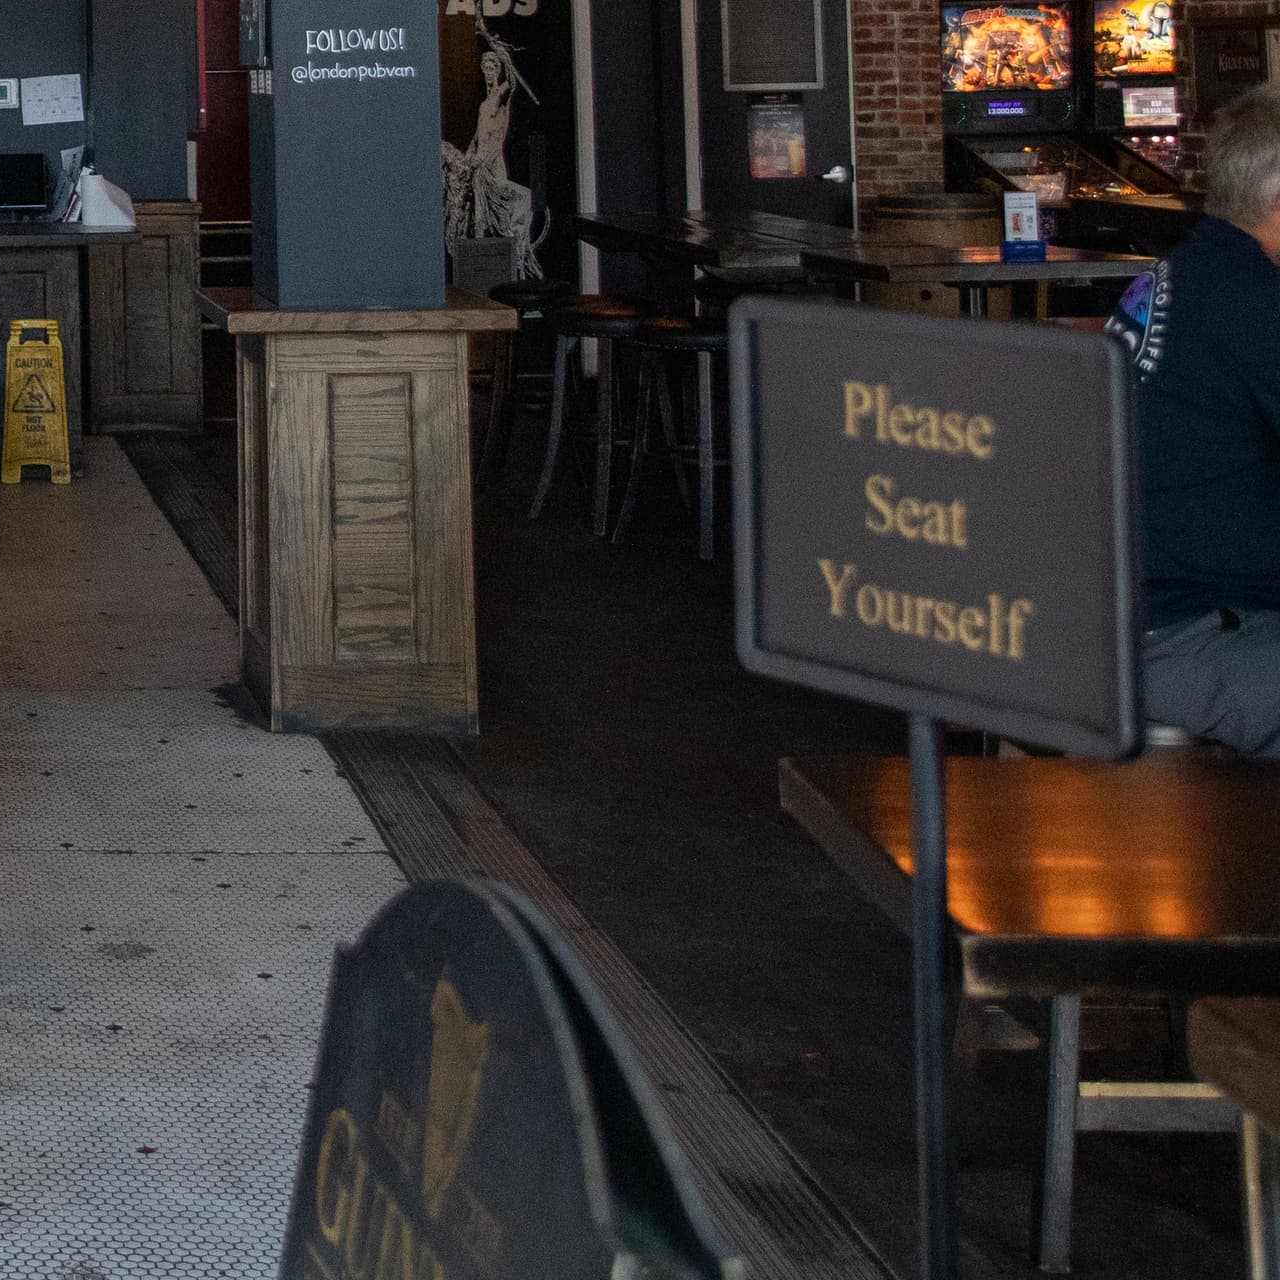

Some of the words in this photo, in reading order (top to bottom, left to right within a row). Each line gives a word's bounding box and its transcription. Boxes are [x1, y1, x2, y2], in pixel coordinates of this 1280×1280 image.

[306, 28, 376, 54] FOLLOW
[379, 28, 406, 50] US!
[291, 60, 415, 83] @londonpubvan
[15, 358, 52, 368] CAUTION
[842, 381, 998, 460] Please
[864, 473, 969, 549] Seat
[818, 557, 1034, 663] Yourself
